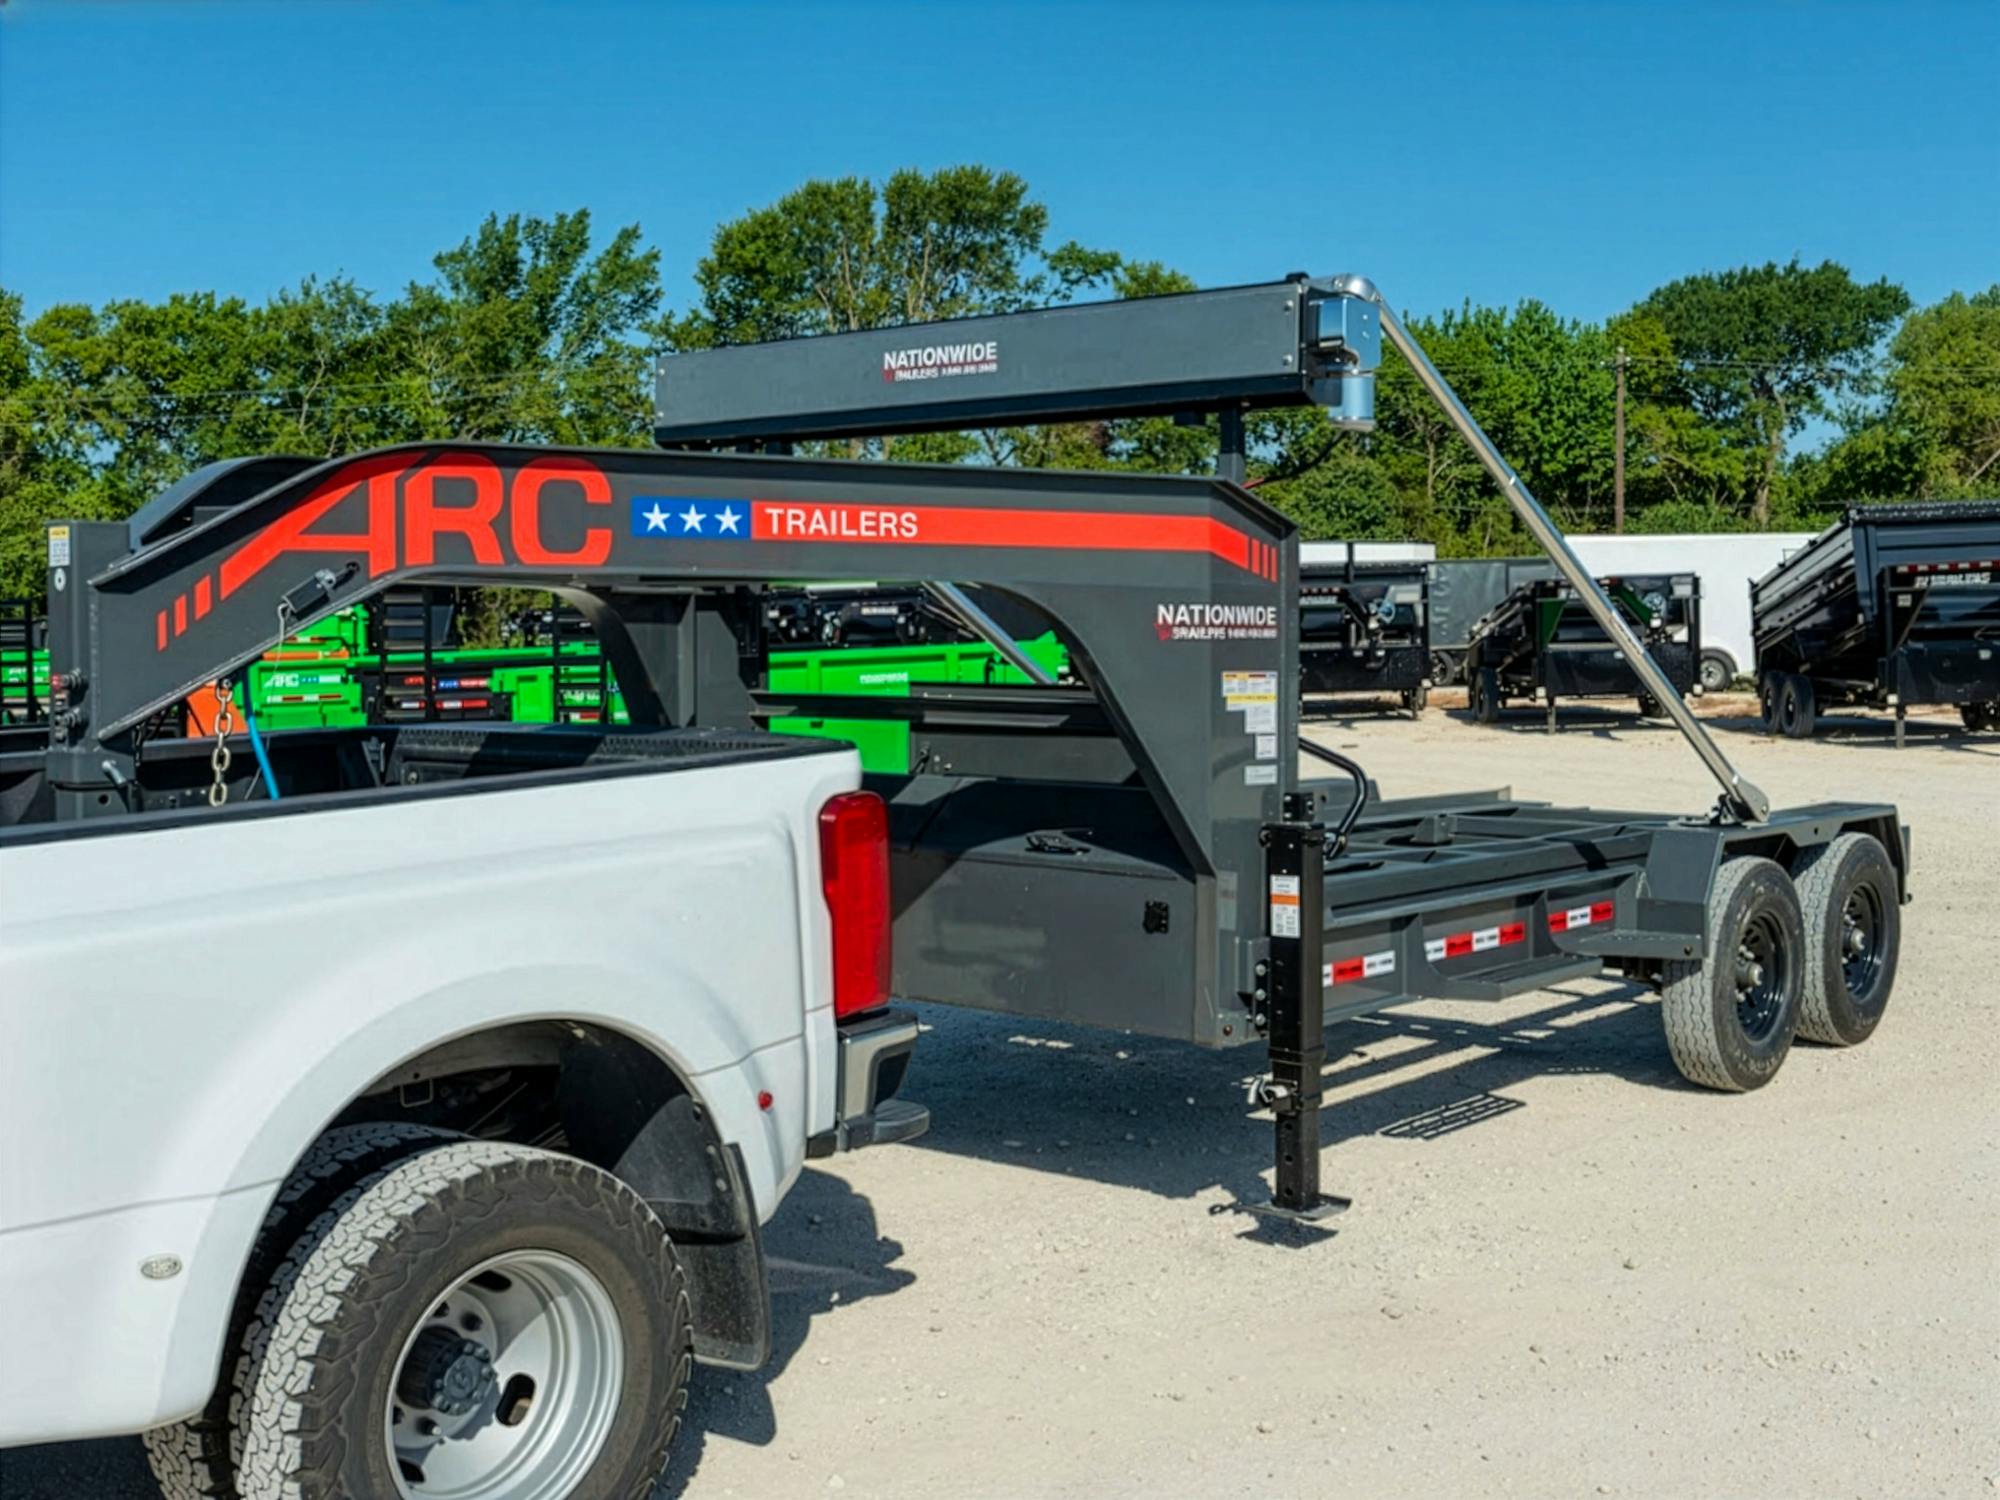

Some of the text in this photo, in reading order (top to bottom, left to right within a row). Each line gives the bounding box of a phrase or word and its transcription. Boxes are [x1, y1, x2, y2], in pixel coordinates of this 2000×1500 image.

[884, 341, 998, 371] NATIONWIDE
[220, 452, 918, 601] ARC TRAILERS
[1157, 604, 1277, 625] NATIONWIDE
